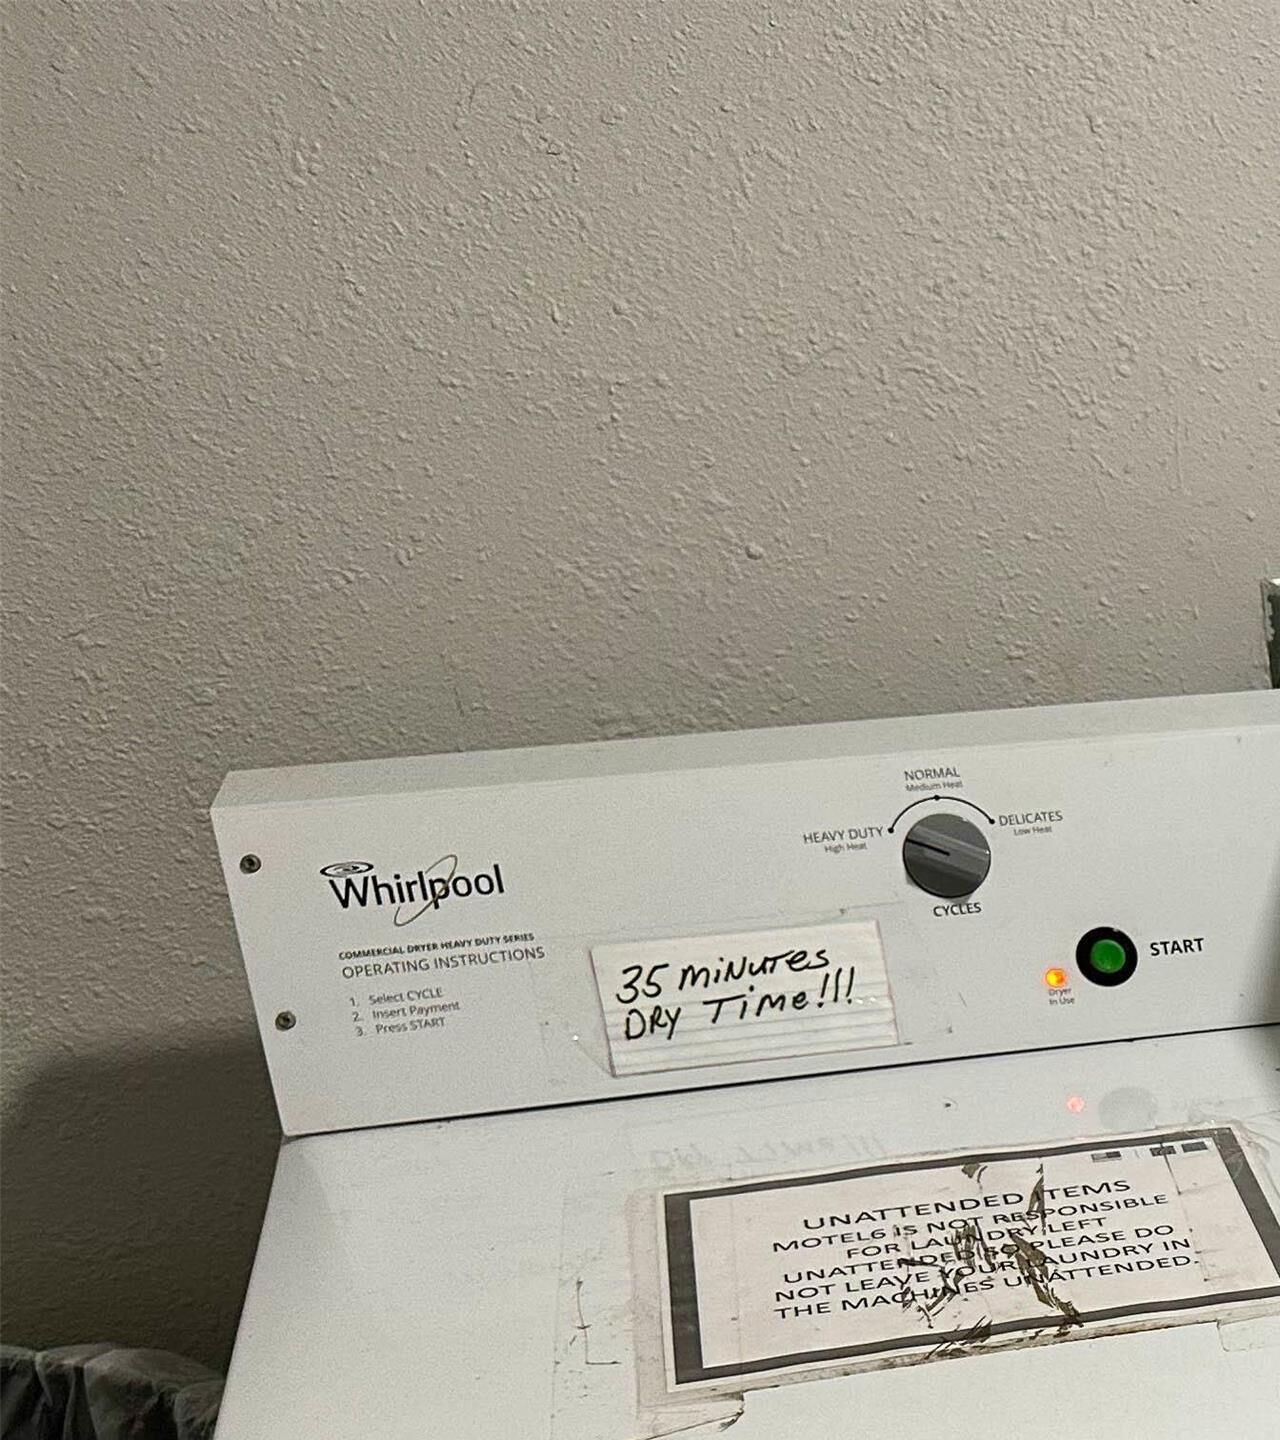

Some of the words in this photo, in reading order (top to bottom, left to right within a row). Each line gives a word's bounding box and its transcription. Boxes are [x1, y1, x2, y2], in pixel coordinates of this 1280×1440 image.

[904, 767, 961, 781] NORMAL
[906, 781, 941, 792] Medium
[943, 780, 963, 790] Heat
[998, 811, 1063, 827] DELICATES
[1014, 827, 1030, 836] Low
[1032, 825, 1052, 834] Heat
[803, 831, 845, 844] HEAVY
[849, 827, 884, 840] DUTY
[824, 843, 841, 854] High
[847, 842, 867, 851] Heat
[329, 864, 504, 910] Whirlpool
[933, 902, 982, 918] CYCLES
[339, 946, 404, 961] COMMERCIAL
[407, 943, 439, 955] DRYER
[440, 939, 473, 950] HEAVY
[475, 936, 501, 947] DUTY
[503, 932, 535, 944] SERIES
[1151, 938, 1204, 957] START
[342, 958, 430, 979] OPERATING
[434, 946, 546, 970] INSTRUCTIONS
[616, 963, 670, 1004] 35
[369, 991, 404, 1006] Select
[407, 987, 443, 1002] CYCLE
[372, 1007, 407, 1020] Insert
[409, 1001, 460, 1018] Payment
[376, 1022, 408, 1035] Press
[410, 1017, 446, 1031] START
[624, 1005, 682, 1041] DRY
[773, 1228, 886, 1252] MOTEL6
[895, 1225, 918, 1237] IS
[927, 1216, 983, 1234] NOT
[993, 1194, 1169, 1224] RESPONSIBLE
[803, 1193, 1023, 1230] UNATTENDED
[847, 1243, 900, 1259] FOR
[1048, 1217, 1107, 1233] LEFT
[784, 1250, 975, 1284] UNATTENDED
[1031, 1230, 1127, 1252] PLEASE
[1135, 1225, 1174, 1239] DO
[775, 1284, 836, 1302] NOT
[846, 1271, 930, 1293] LEAVE
[939, 1261, 1018, 1279] YOUR
[1164, 1238, 1190, 1251] IN
[774, 1302, 832, 1319] THE
[842, 1278, 995, 1311] MACHINES
